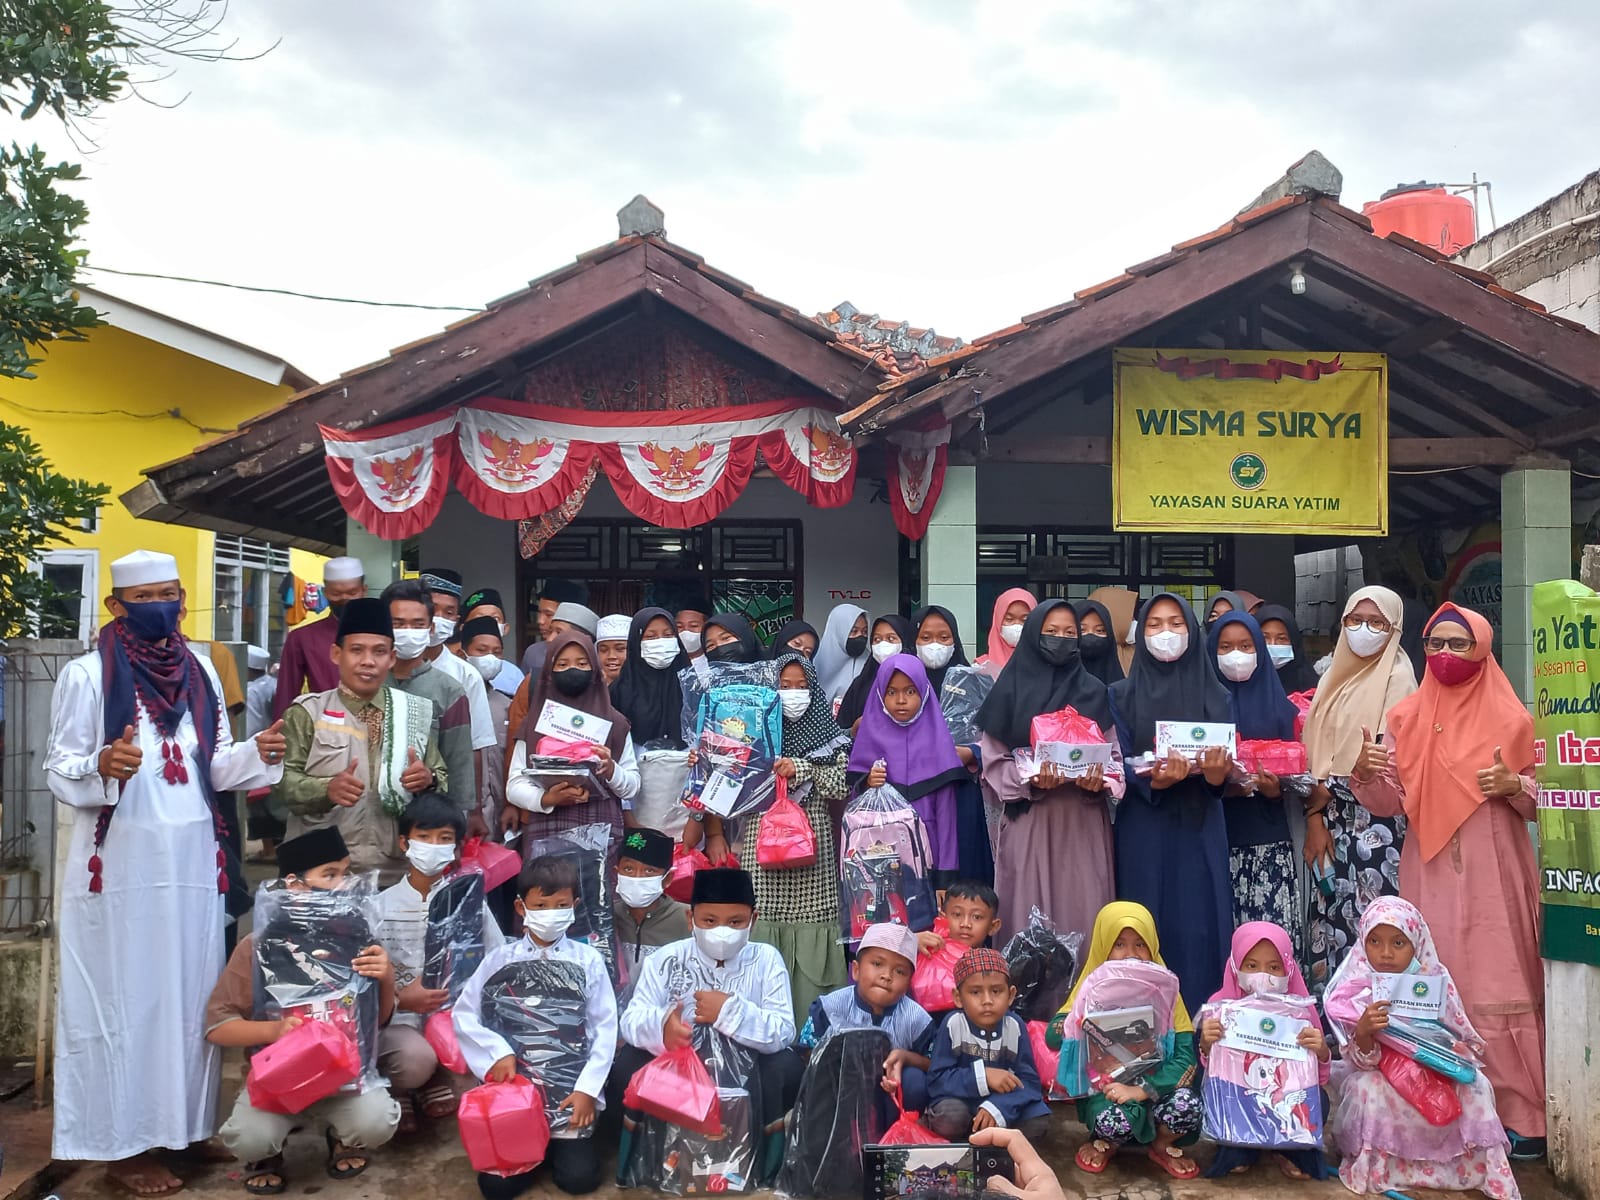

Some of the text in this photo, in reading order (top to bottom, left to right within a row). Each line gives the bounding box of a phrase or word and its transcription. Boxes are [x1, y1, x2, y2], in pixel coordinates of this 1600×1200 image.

[1136, 408, 1361, 439] WISMA SURYA
[1149, 495, 1340, 511] YAYASAN SUARA YATIM
[1551, 614, 1600, 651] Yat
[1543, 659, 1588, 677] Sesama
